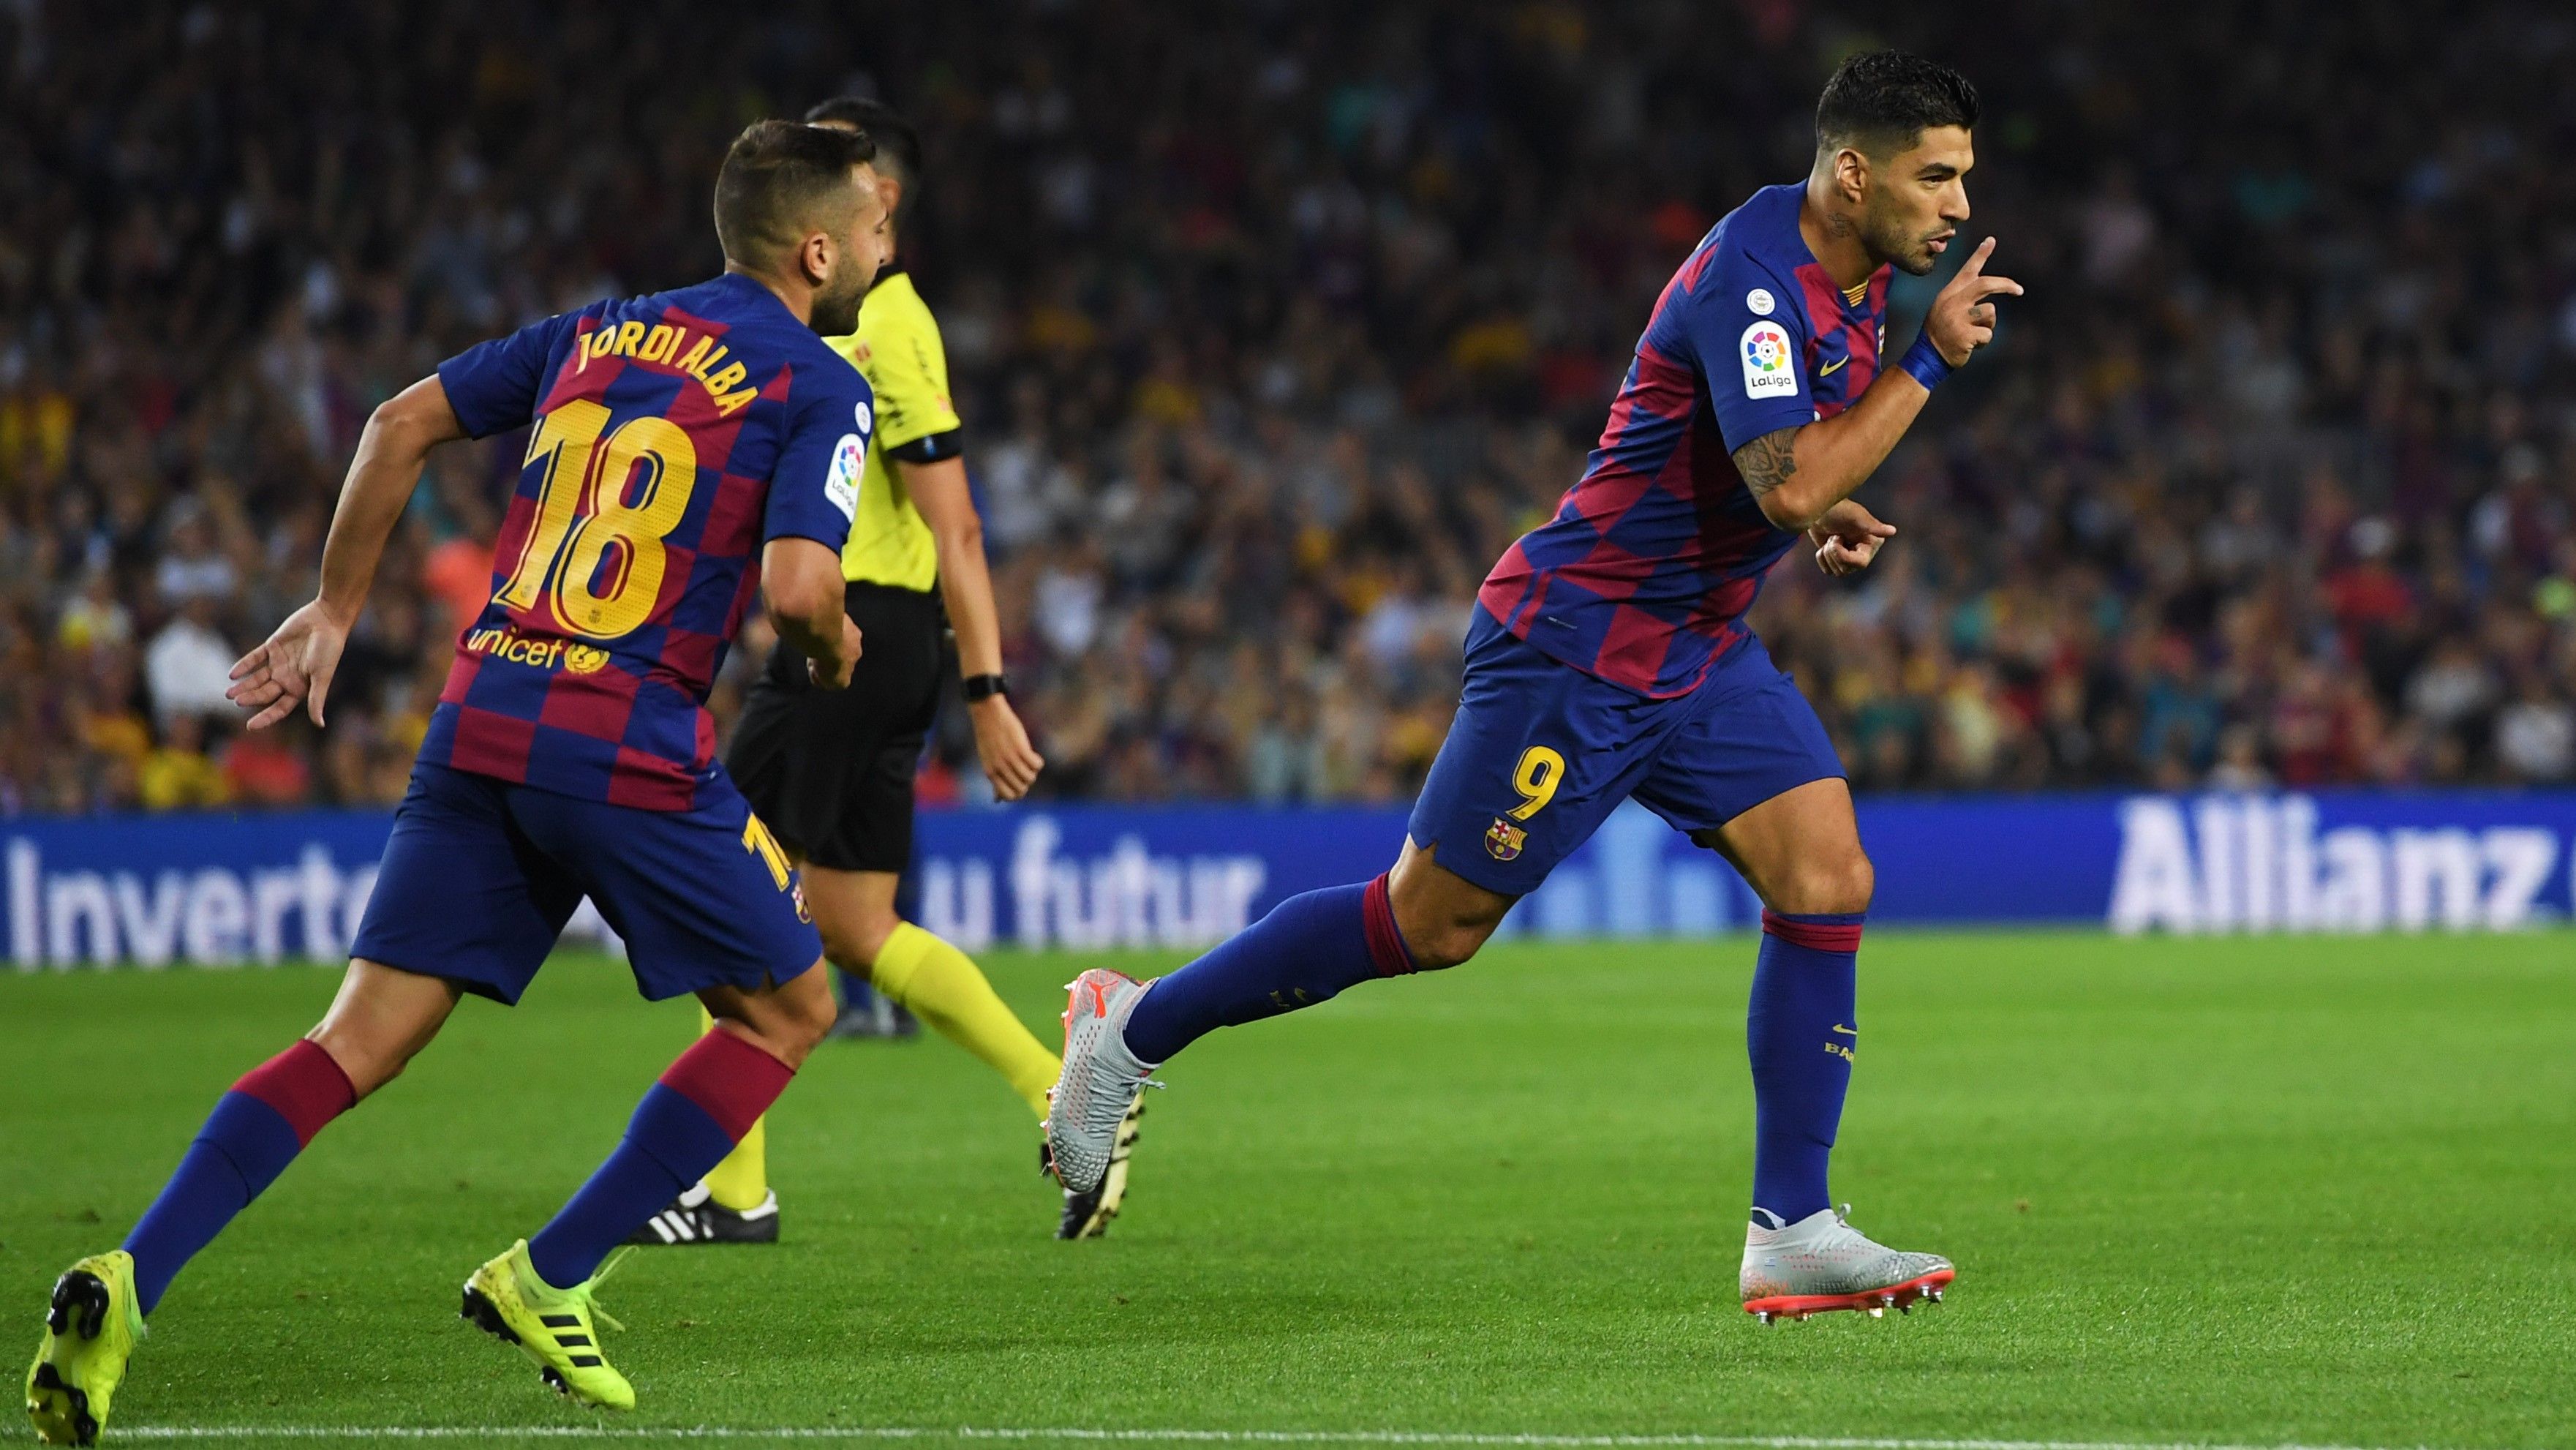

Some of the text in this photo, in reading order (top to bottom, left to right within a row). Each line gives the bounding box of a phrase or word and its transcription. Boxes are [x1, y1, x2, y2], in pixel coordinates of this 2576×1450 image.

[576, 320, 759, 418] JORDI ALBA
[1751, 374, 1791, 388] LaLiga
[492, 398, 697, 640] 18
[1504, 745, 1565, 822] 9
[741, 811, 792, 892] 1
[1012, 814, 1267, 953] futur
[2110, 796, 2560, 936] Allianz
